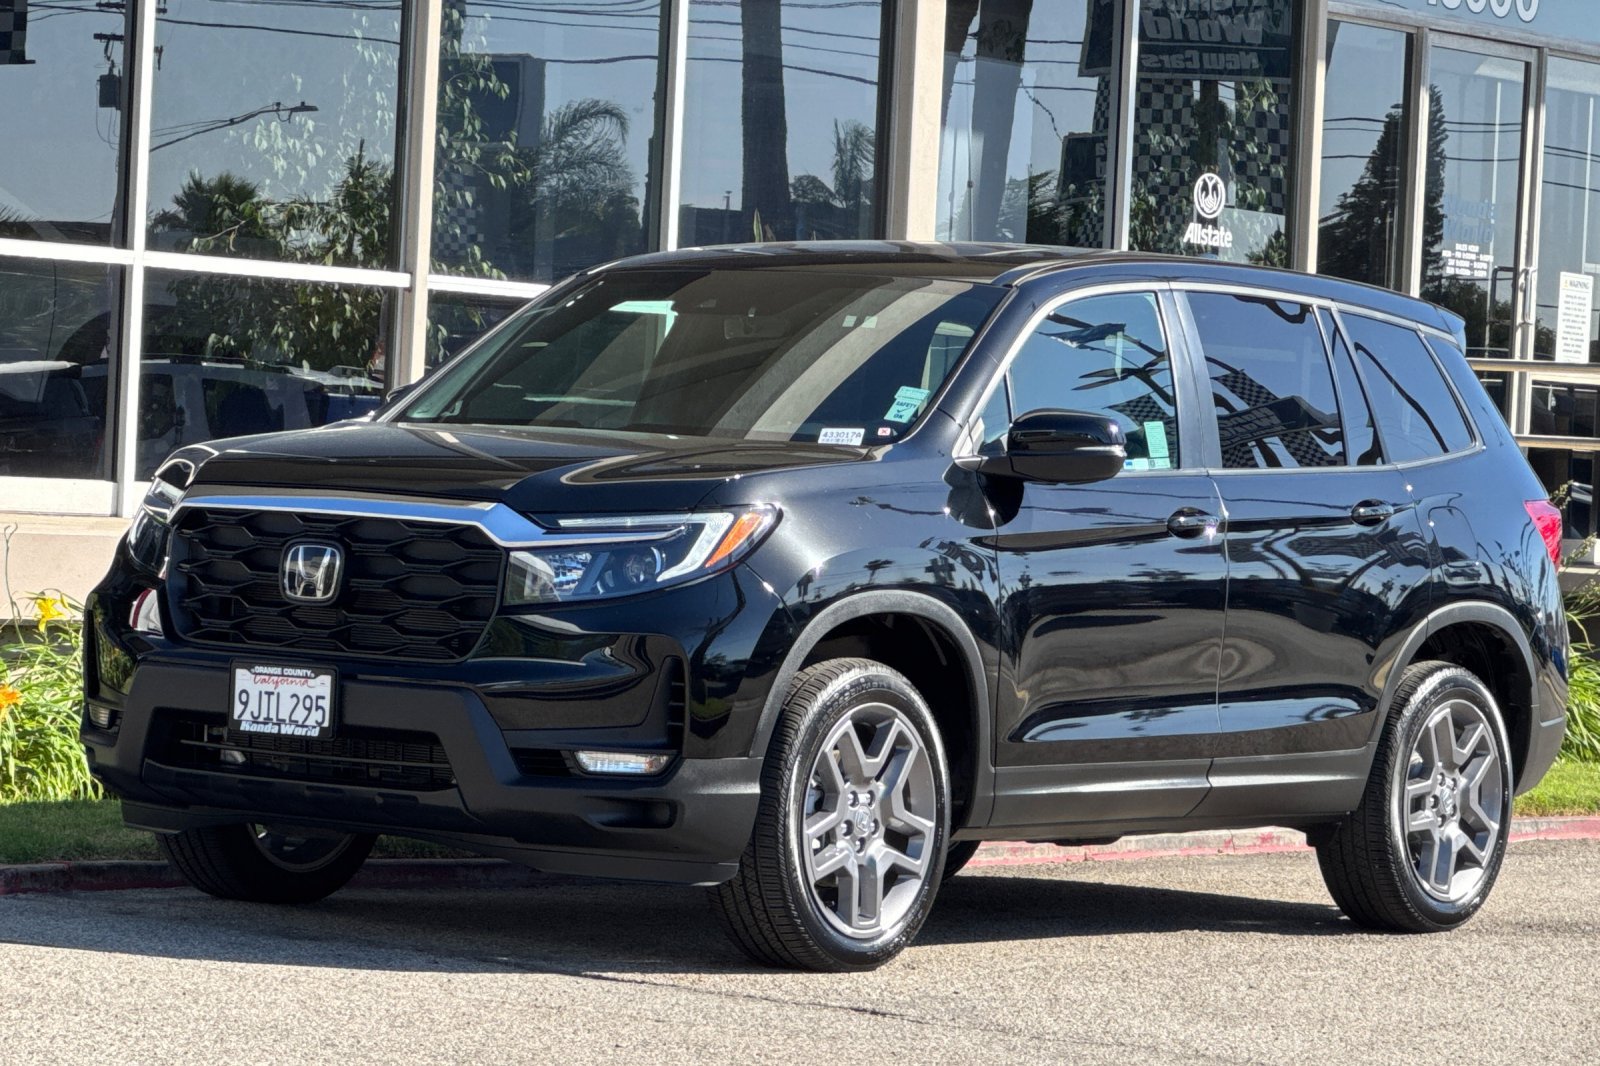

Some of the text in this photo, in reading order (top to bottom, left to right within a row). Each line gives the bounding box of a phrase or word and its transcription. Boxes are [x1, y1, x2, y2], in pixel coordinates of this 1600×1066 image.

[1183, 222, 1232, 248] Allstate
[895, 401, 917, 409] SAFETY
[254, 665, 312, 678] ORANGE COUNTY
[253, 674, 315, 689] California
[237, 689, 326, 727] 9JIL295
[240, 720, 320, 737] Honda World
